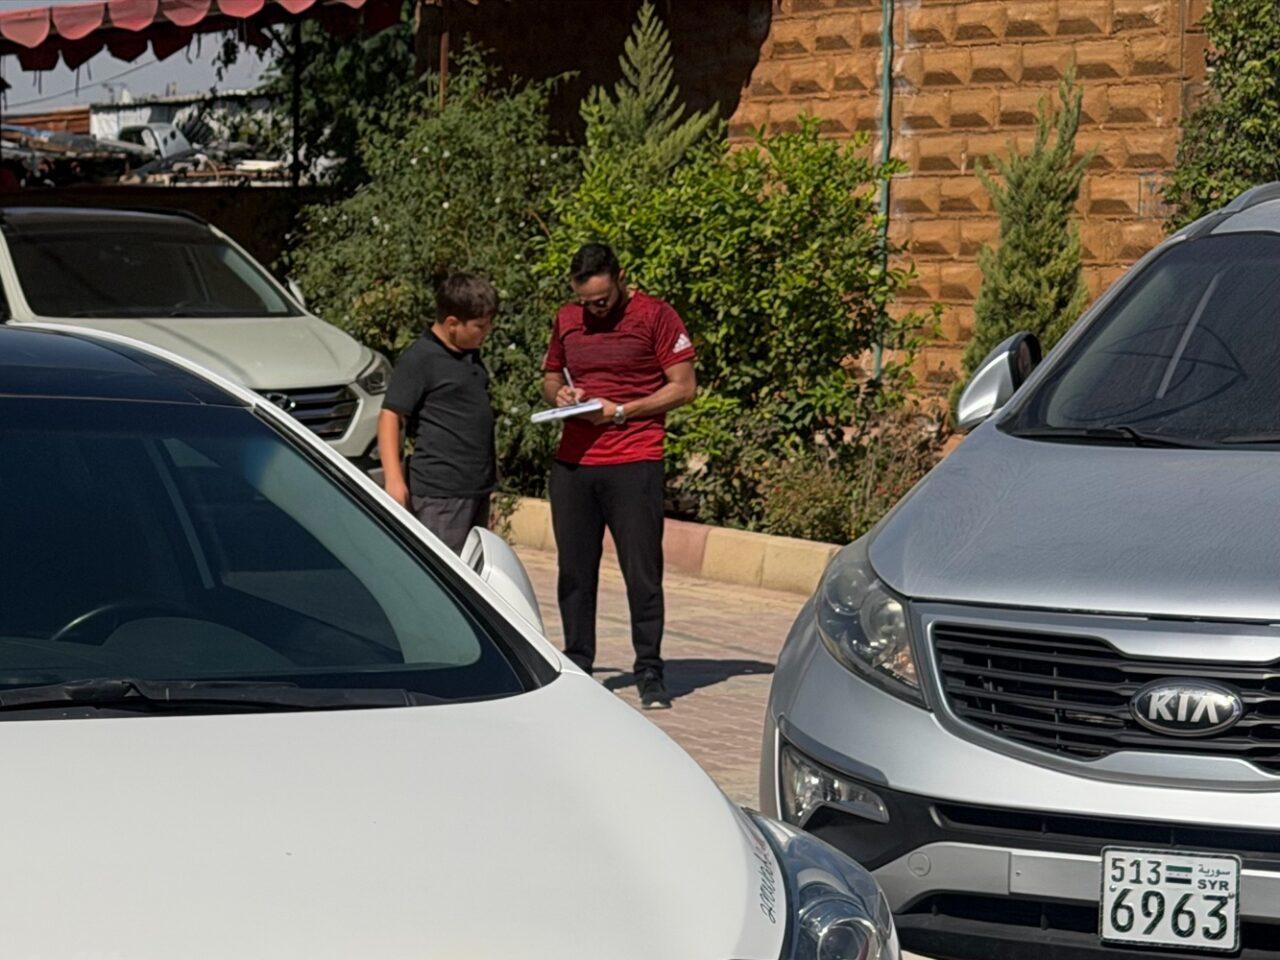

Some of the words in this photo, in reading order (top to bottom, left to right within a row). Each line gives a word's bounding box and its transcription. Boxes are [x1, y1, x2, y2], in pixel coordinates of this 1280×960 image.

[1148, 692, 1220, 724] KIA
[1111, 857, 1162, 886] 513
[1197, 863, 1231, 878] سورية
[1197, 878, 1230, 891] SYR
[1110, 887, 1229, 941] 6963
